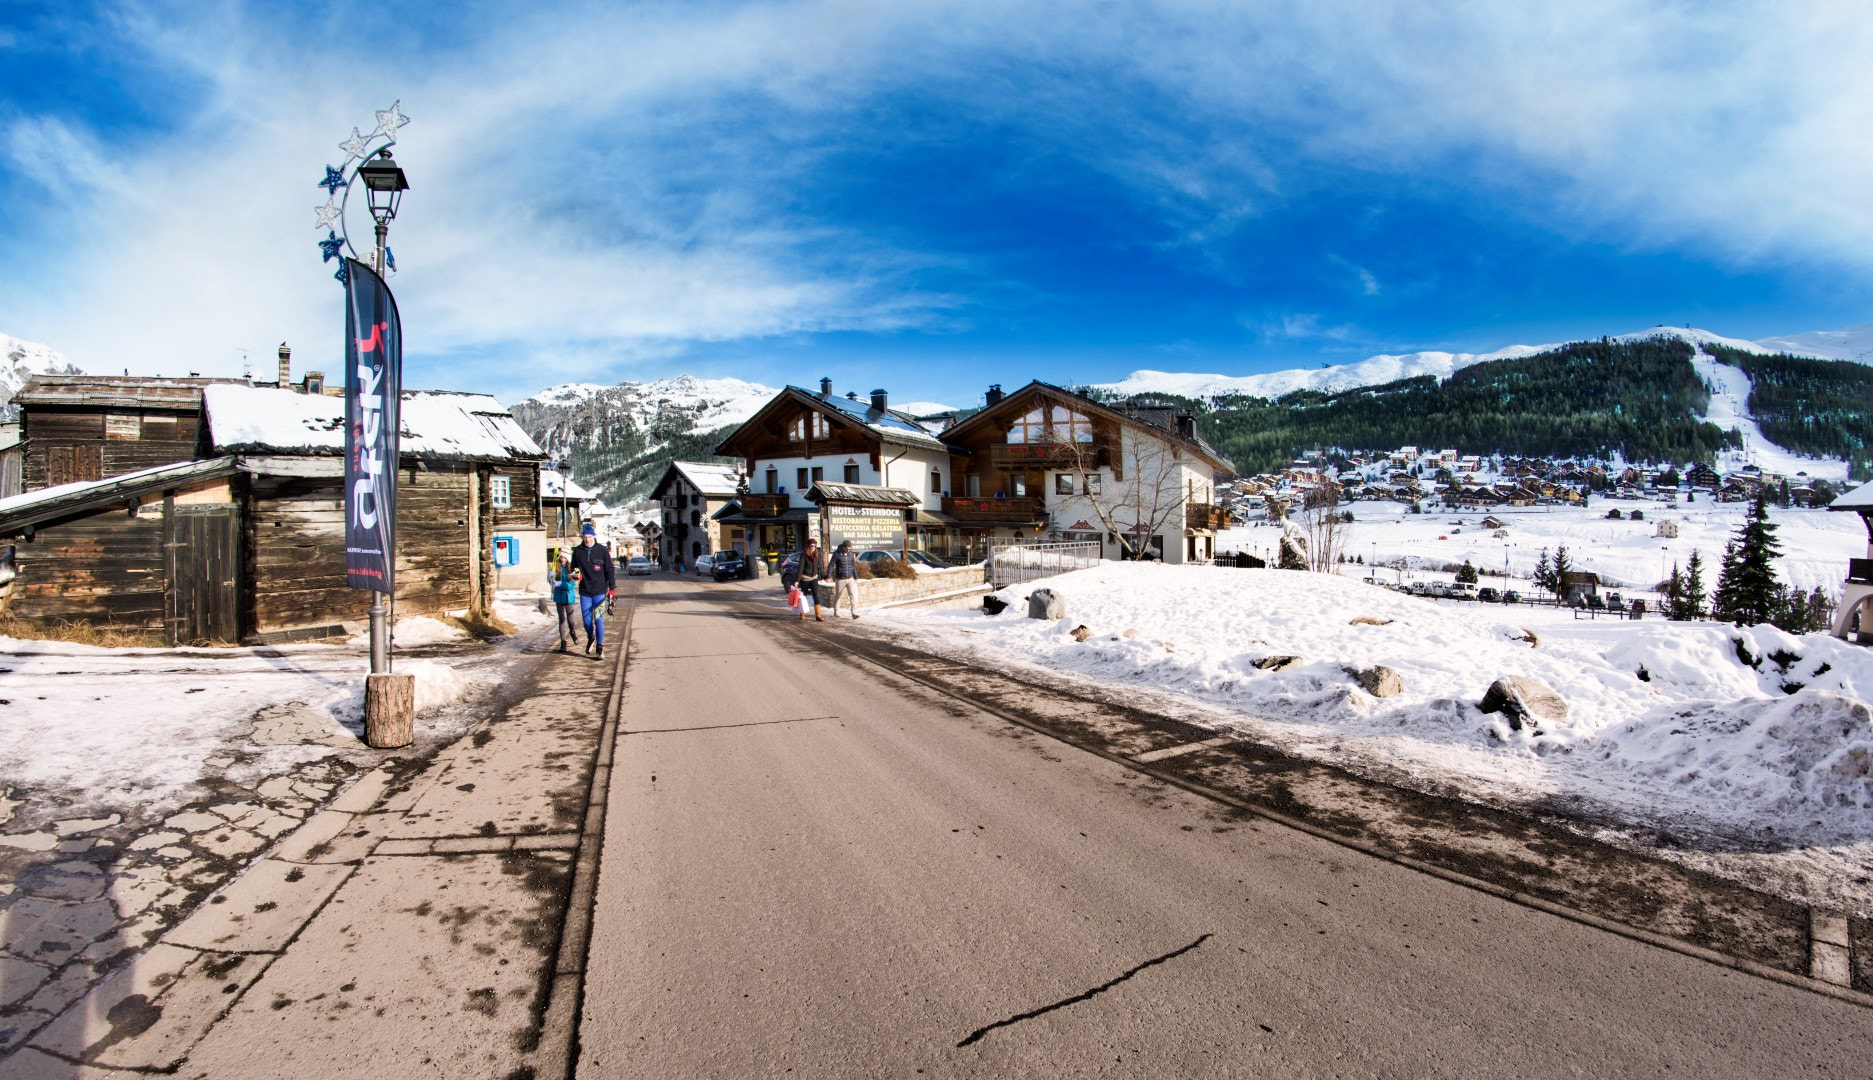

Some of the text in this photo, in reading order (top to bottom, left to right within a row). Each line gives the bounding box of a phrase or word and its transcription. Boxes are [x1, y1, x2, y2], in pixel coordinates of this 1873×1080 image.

[831, 507, 900, 517] HOTEL STEINBOCK
[832, 517, 871, 525] RISTORANTE
